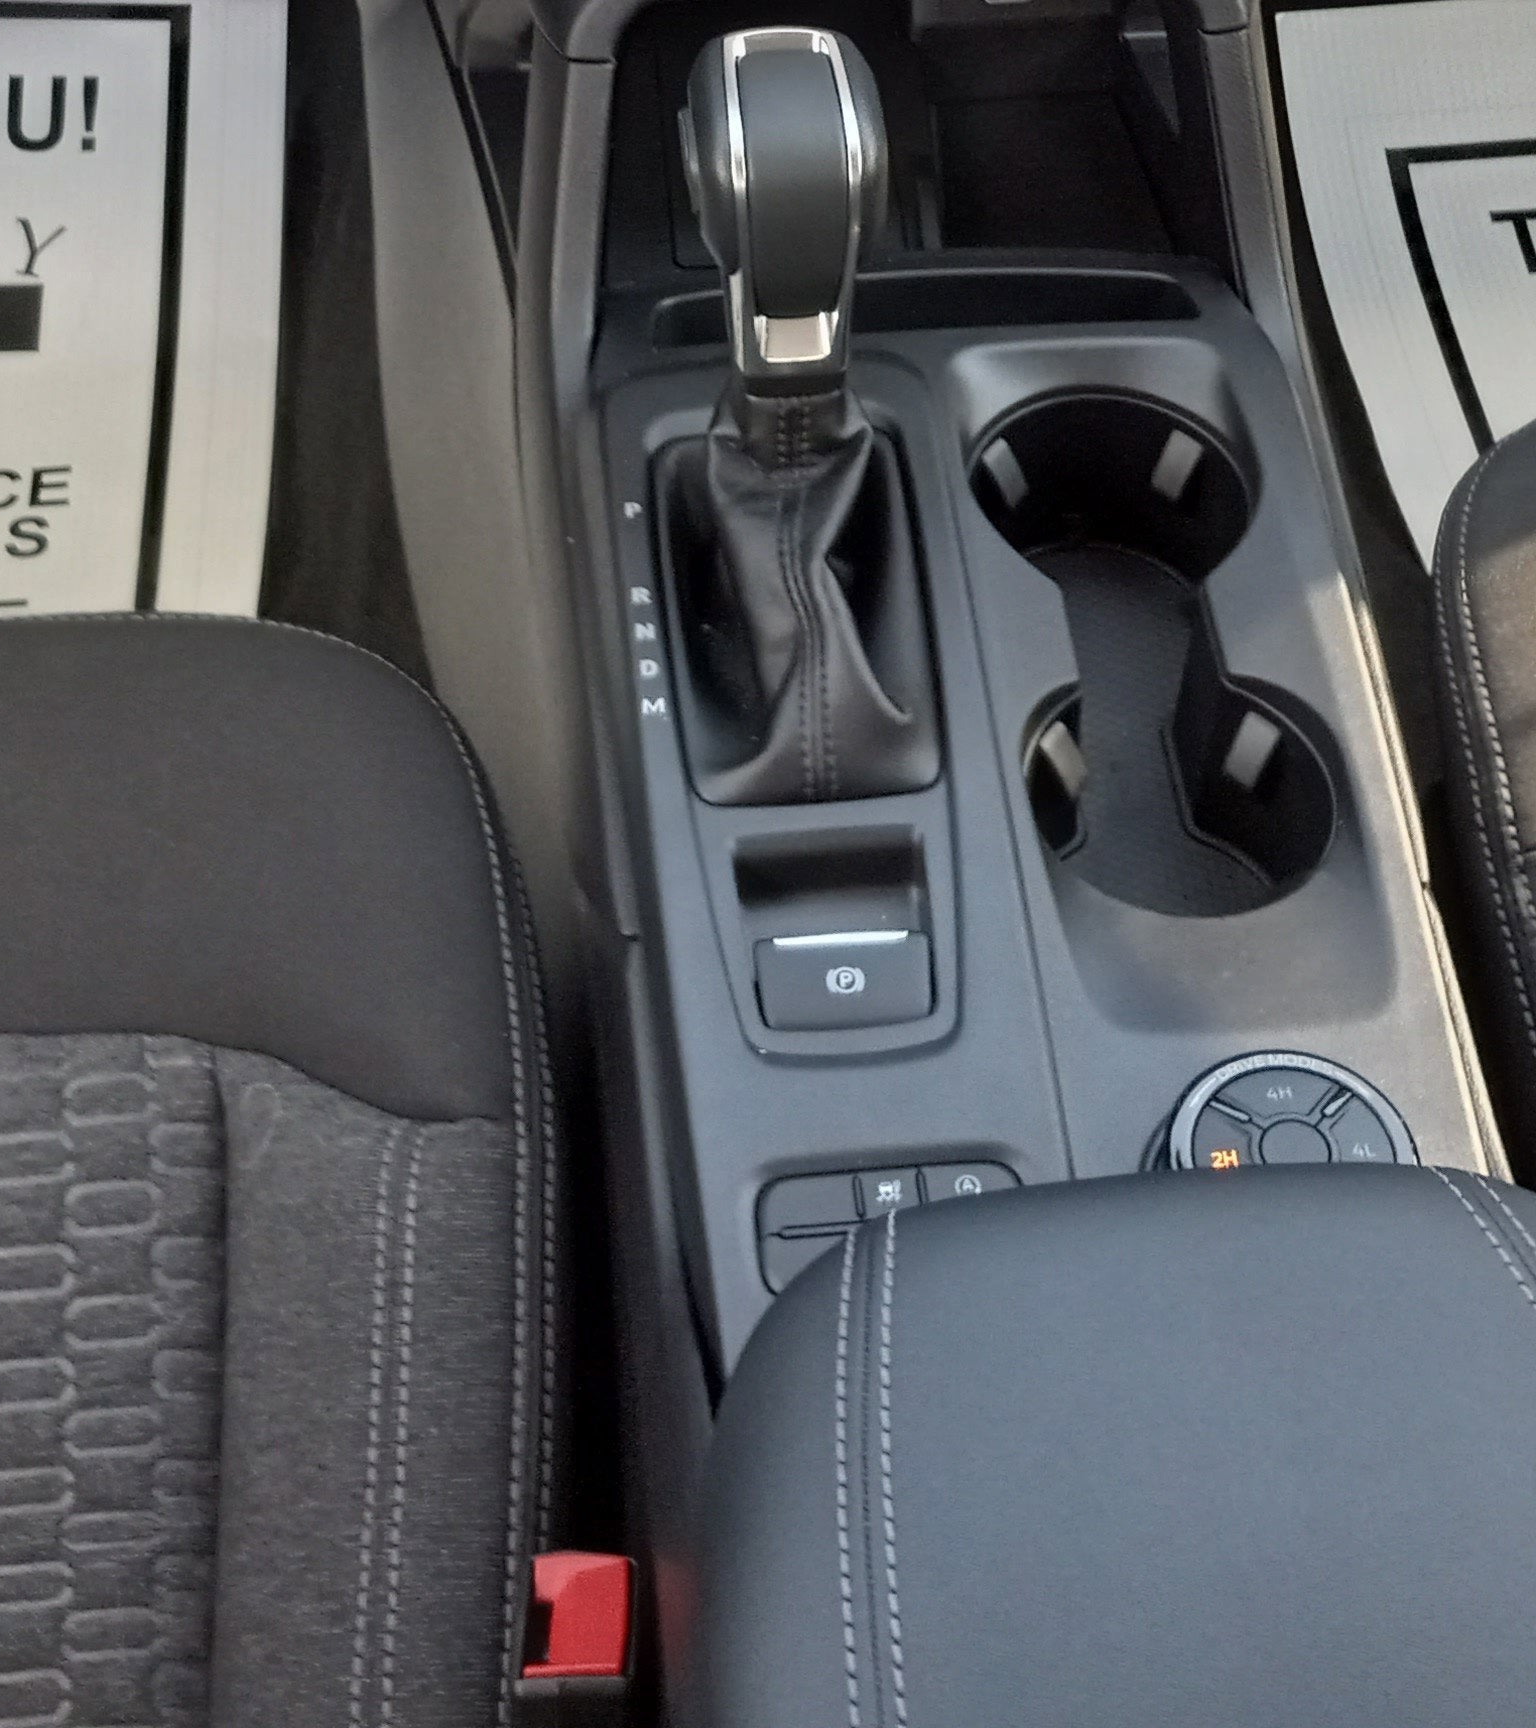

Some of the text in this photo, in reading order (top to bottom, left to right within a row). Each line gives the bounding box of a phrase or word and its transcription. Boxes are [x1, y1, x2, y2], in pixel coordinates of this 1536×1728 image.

[624, 502, 643, 519] P
[630, 586, 653, 605] R
[633, 622, 656, 641] N
[639, 658, 660, 678] D
[642, 697, 665, 714] M
[1215, 1054, 1266, 1082] DRIVE
[1267, 1086, 1293, 1100] 4H
[1210, 1149, 1240, 1170] 2H
[1352, 1143, 1377, 1158] 4L
